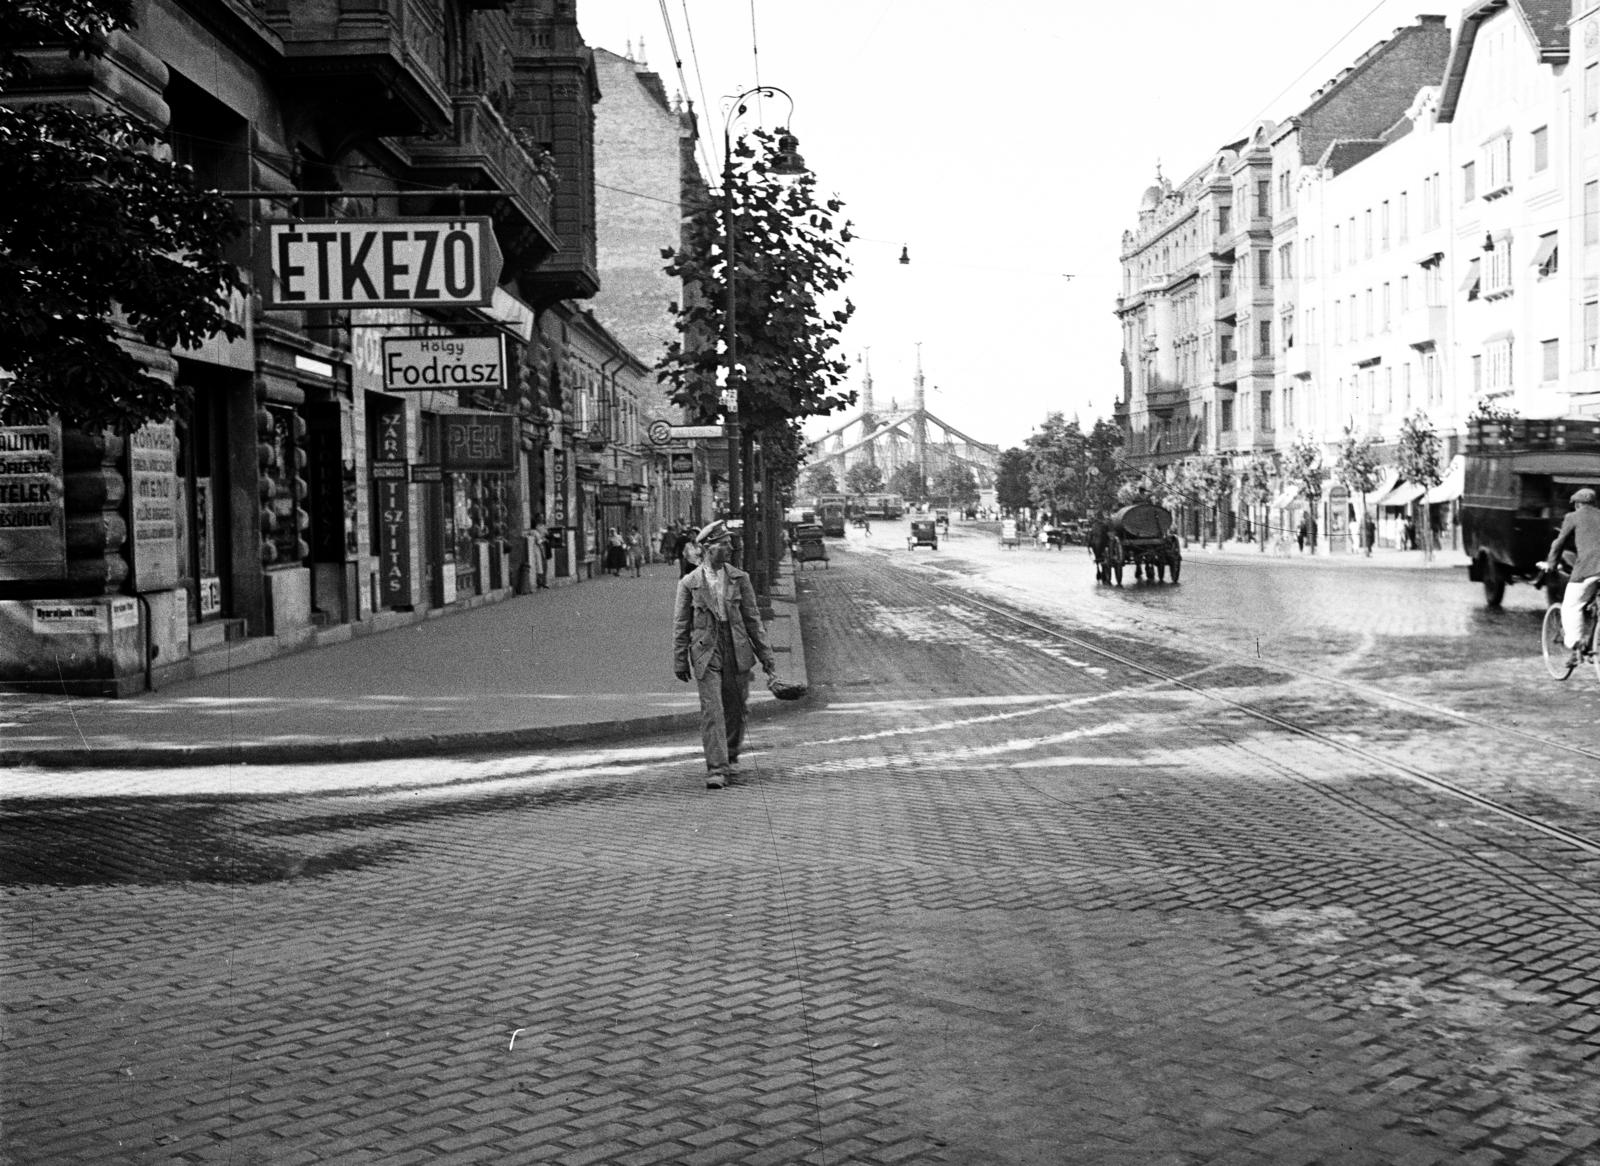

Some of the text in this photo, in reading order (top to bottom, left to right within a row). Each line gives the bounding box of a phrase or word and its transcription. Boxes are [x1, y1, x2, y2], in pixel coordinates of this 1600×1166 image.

[420, 339, 464, 355] Hölgy
[388, 352, 499, 385] Fodrász
[554, 454, 565, 521] MODIANO
